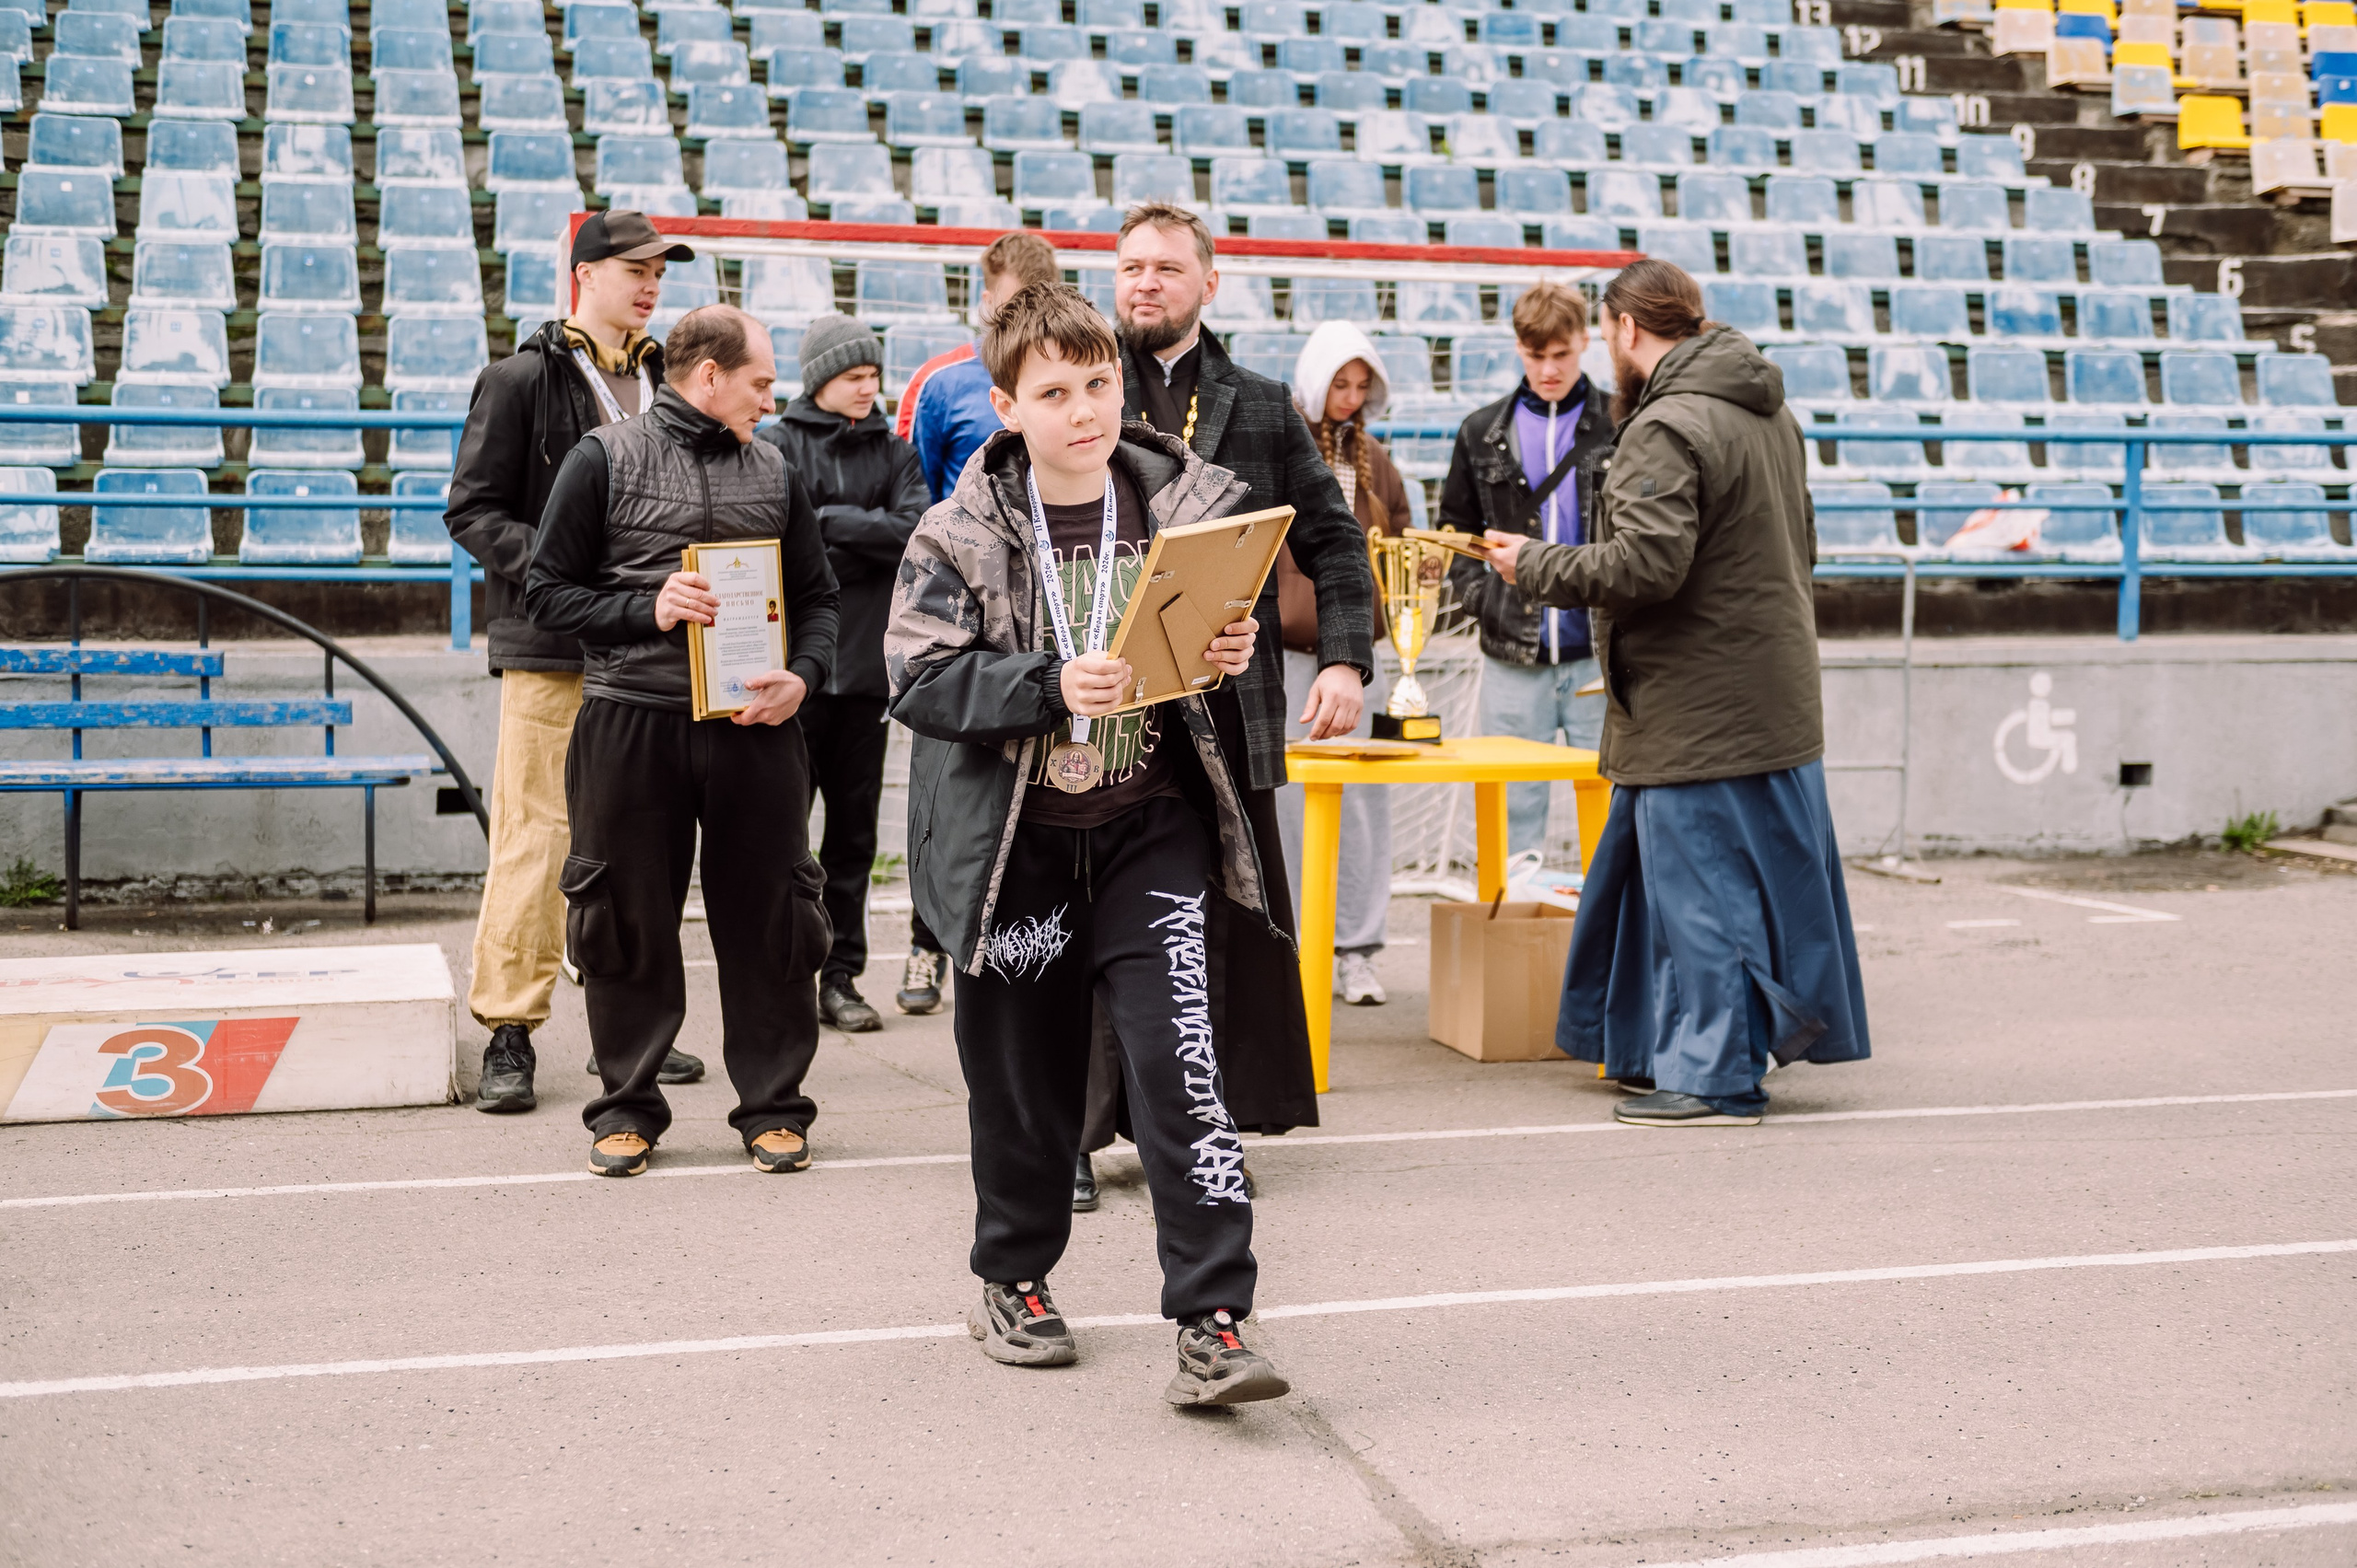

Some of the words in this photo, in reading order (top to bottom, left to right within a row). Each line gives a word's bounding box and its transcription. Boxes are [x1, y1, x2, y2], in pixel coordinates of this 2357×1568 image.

[1895, 54, 1927, 92] 11
[2011, 122, 2036, 161] 9
[2071, 161, 2096, 199] 8
[2142, 203, 2165, 237] 7
[2218, 257, 2245, 298] 6
[95, 1024, 213, 1116] 3
